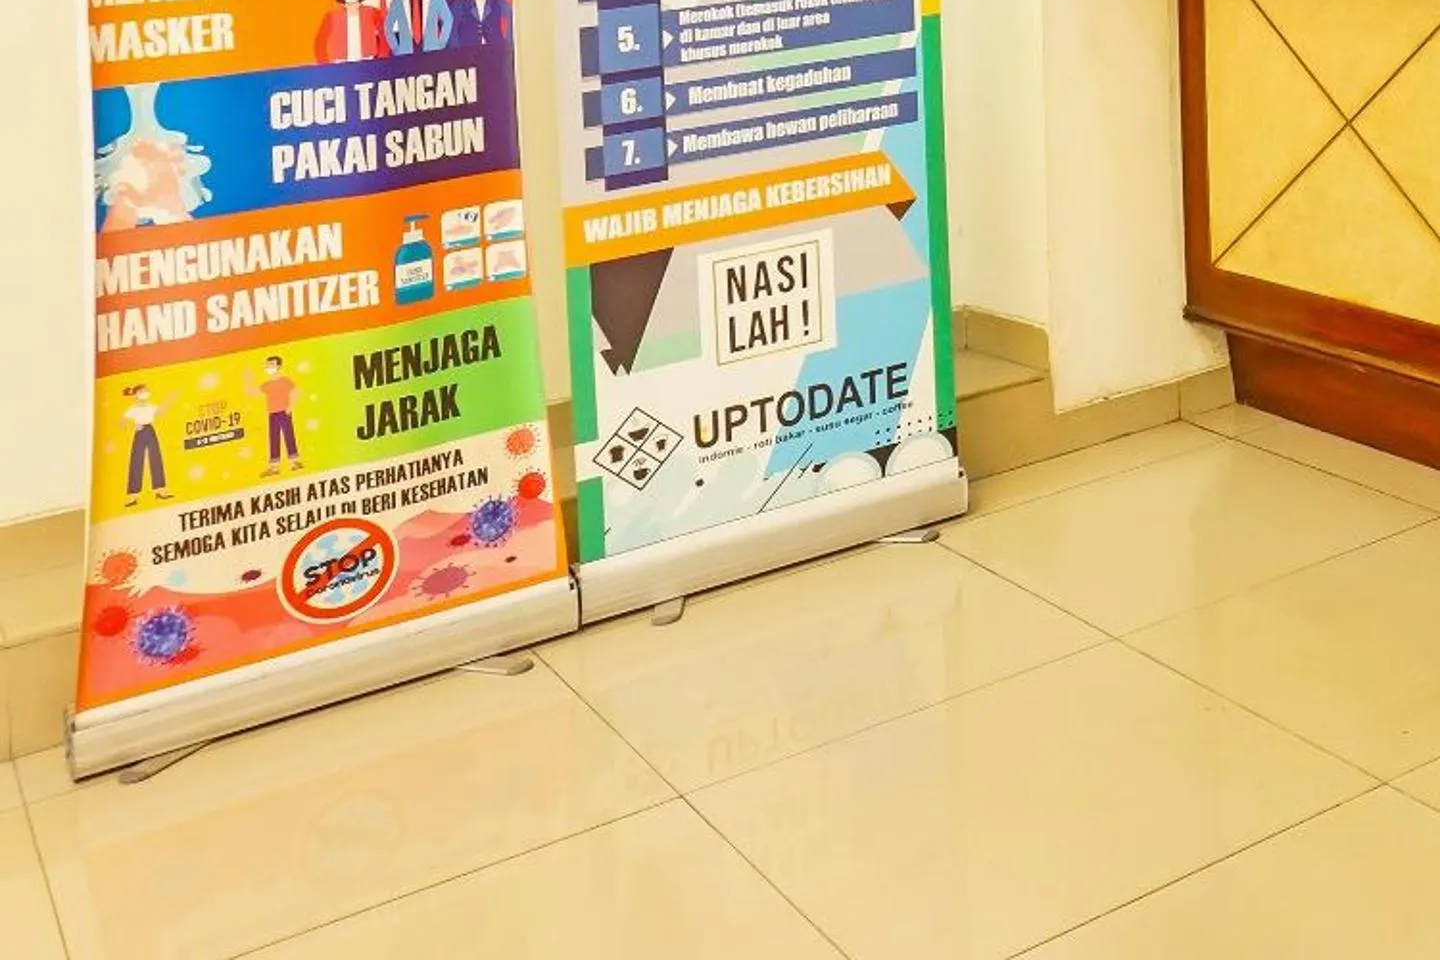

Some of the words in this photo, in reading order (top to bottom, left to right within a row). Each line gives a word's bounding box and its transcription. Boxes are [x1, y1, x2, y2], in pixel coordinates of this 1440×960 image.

[88, 12, 235, 63] MASKER
[617, 25, 640, 53] 5.
[680, 43, 727, 62] khusus
[269, 86, 346, 132] CUCI
[354, 67, 478, 121] TANGAN
[620, 88, 643, 115] 6.
[688, 77, 764, 105] Membuat
[766, 64, 852, 93] kegaduhan
[271, 135, 379, 184] PAKAI
[384, 115, 486, 175] SABUN
[621, 139, 641, 166] 7.
[682, 124, 764, 154] Membawa
[765, 114, 817, 139] hewan
[583, 208, 658, 243] WAJIB
[662, 187, 762, 229] MENJAGA
[766, 163, 892, 208] KEBERSIHAN
[96, 221, 343, 297] MENGUNAKAN
[726, 252, 808, 305] NASI
[97, 299, 197, 352] HAND
[206, 269, 380, 333] SANITIZER
[729, 305, 790, 354] LAH
[352, 325, 502, 391] MENJAGA
[355, 384, 461, 440] JARAK
[693, 362, 909, 449] UPTODATE
[698, 445, 744, 464] indomie
[152, 531, 226, 565] SEMOGA
[231, 521, 271, 547] KITA
[362, 492, 396, 516] BERI
[401, 466, 489, 507] KESEHATAN
[179, 500, 244, 532] TERIMA
[251, 487, 300, 516] KASIH
[306, 475, 350, 502] ATAS
[356, 448, 464, 492] PERHATIANYA
[303, 547, 377, 587] STOP
